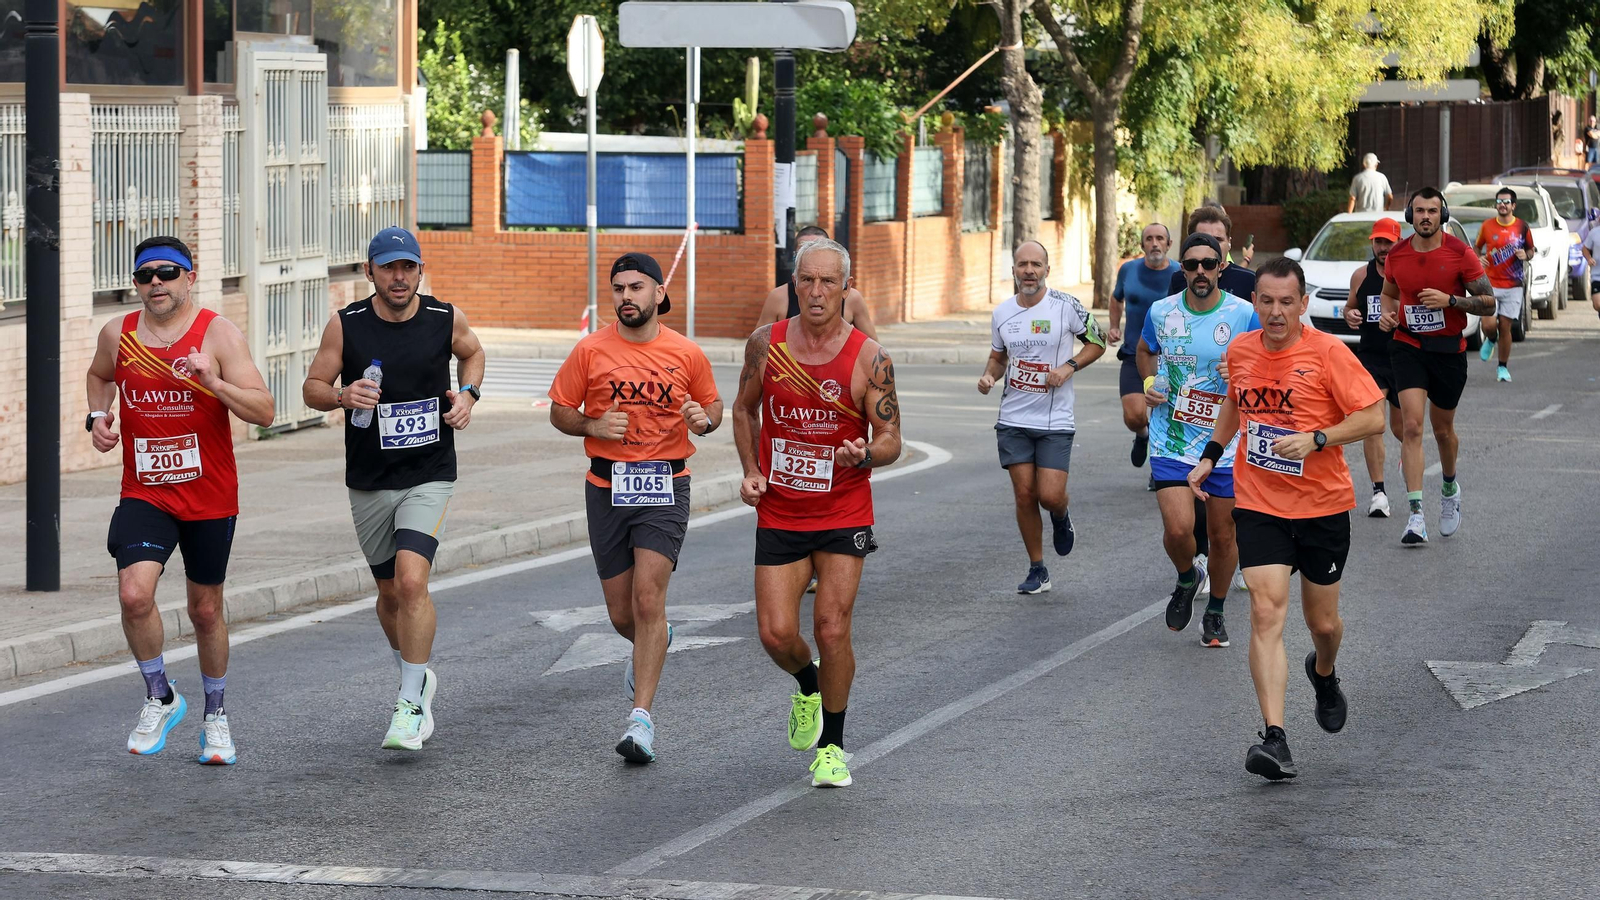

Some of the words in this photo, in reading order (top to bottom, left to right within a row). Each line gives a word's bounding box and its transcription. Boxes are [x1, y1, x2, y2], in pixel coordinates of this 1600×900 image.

[1414, 313, 1434, 324] 590
[1018, 370, 1039, 384] 274
[131, 389, 193, 403] LAWDE
[157, 404, 195, 412] Consulting
[779, 405, 838, 421] LAWDE
[1187, 401, 1214, 417] 535
[395, 416, 426, 434] 693
[802, 421, 838, 431] Consulting
[150, 452, 184, 470] 200
[784, 456, 817, 476] 325
[623, 476, 664, 492] 1065
